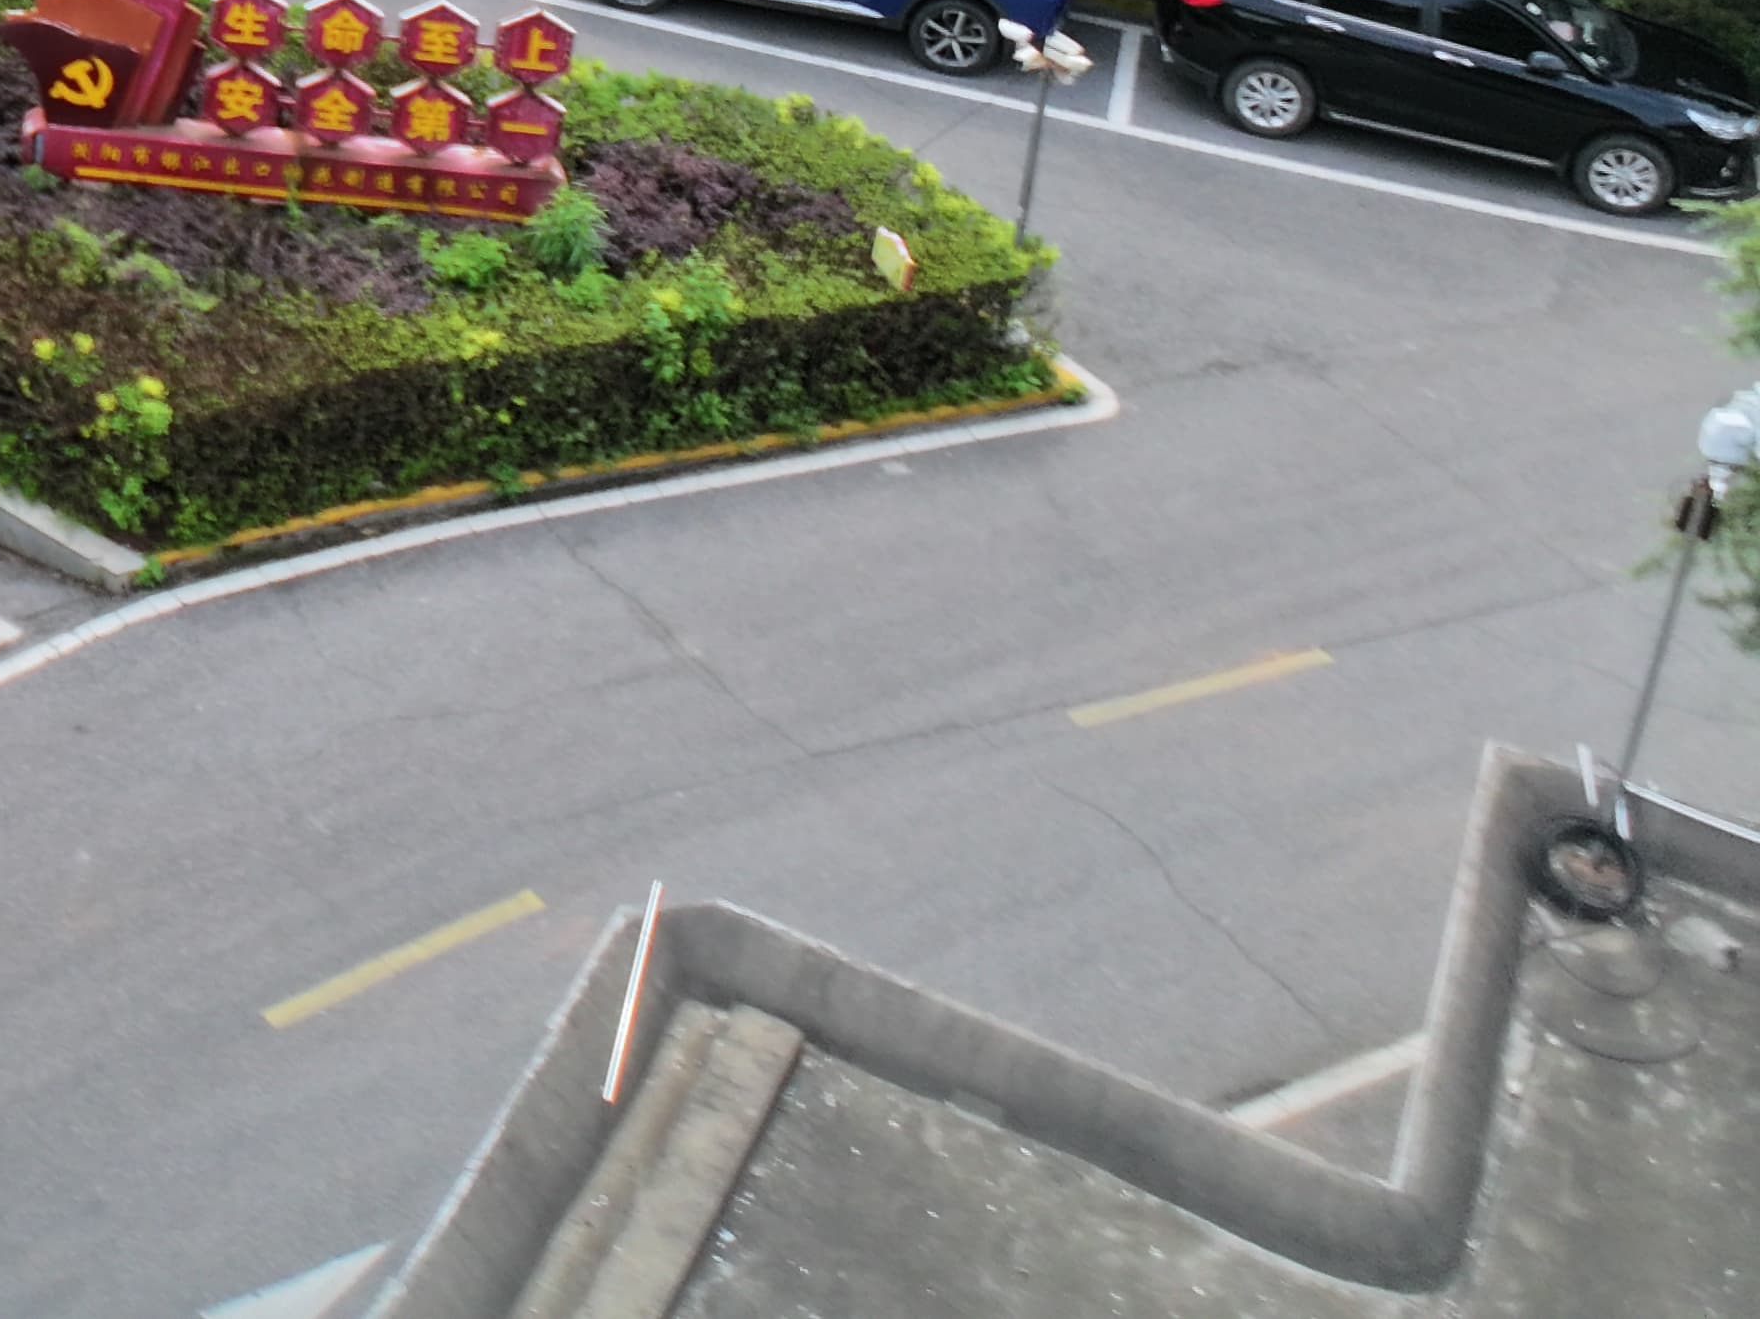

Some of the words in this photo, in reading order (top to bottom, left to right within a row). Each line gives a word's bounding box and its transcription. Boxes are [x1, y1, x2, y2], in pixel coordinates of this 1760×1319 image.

[222, 1, 557, 74] 生命至上
[215, 77, 549, 142] 安全第一
